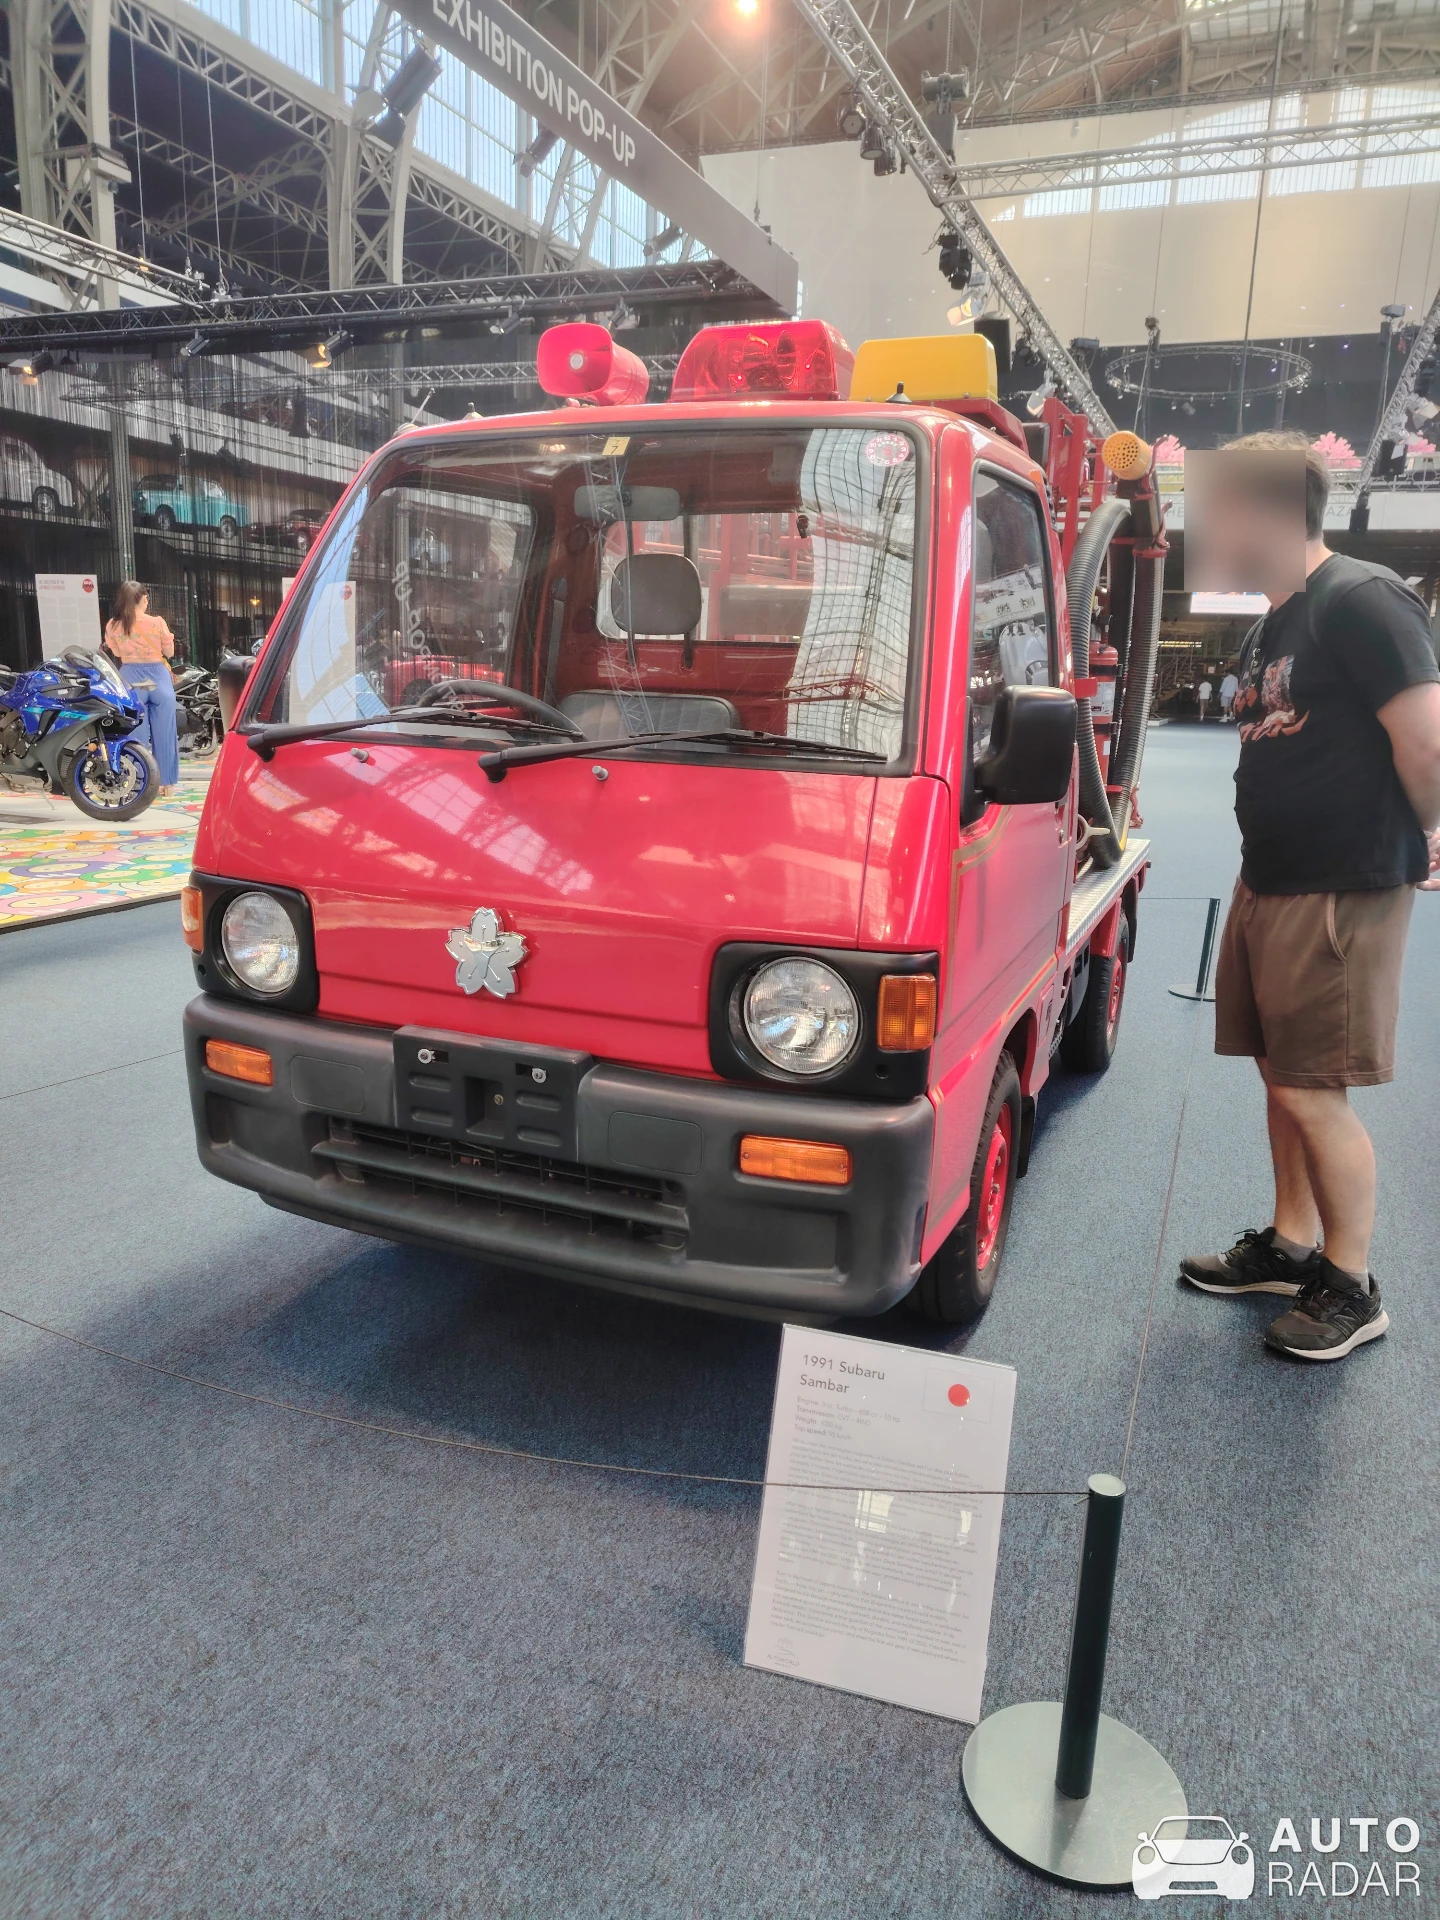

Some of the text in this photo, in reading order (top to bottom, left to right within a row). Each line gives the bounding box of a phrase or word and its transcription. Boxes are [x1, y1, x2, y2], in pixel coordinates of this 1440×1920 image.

[433, 0, 636, 167] EXHIBITION POP-UP
[803, 1354, 885, 1380] 1991 Subaru
[799, 1373, 850, 1394] Sambar
[795, 1415, 818, 1426] Weight:
[856, 1417, 871, 1426] 4WD
[892, 1415, 901, 1423] hp
